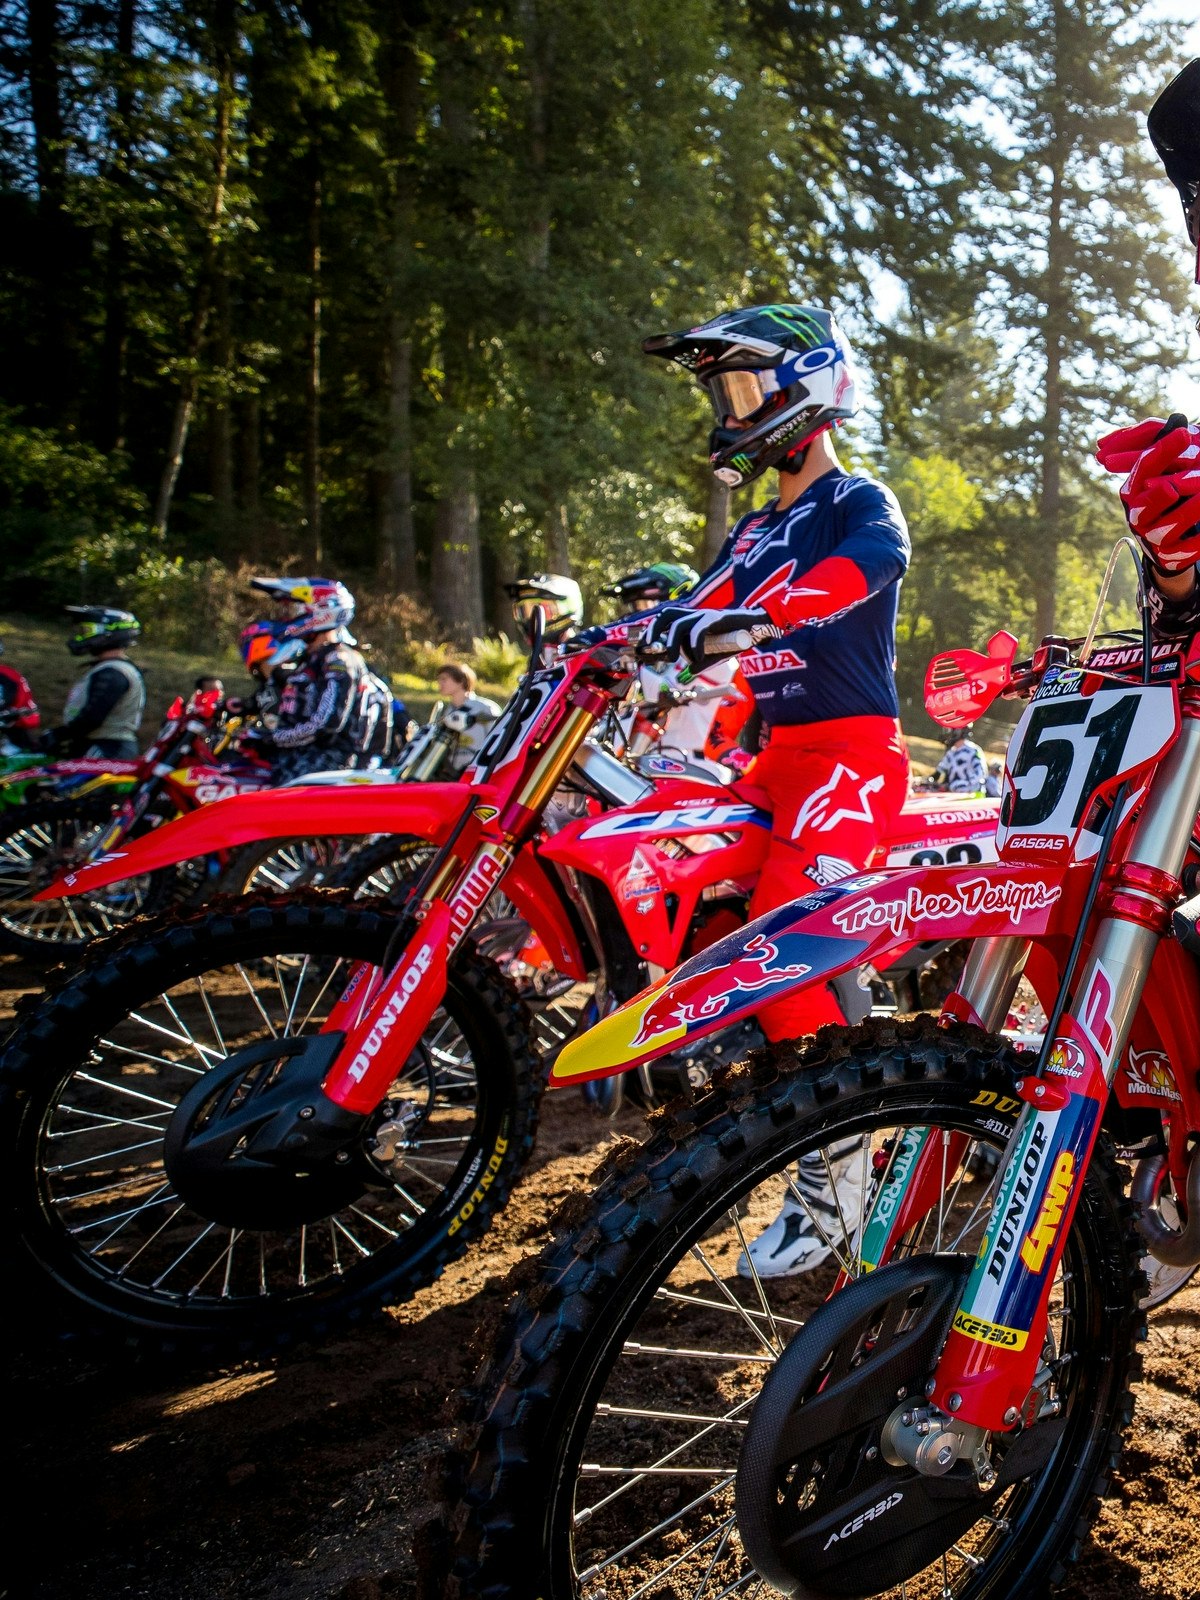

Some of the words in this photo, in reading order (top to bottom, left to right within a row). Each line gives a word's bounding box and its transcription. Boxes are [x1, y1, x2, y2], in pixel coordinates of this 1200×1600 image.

[1033, 683, 1062, 701] LUCAS
[1062, 680, 1081, 694] OIL
[1000, 694, 1143, 828] 51
[577, 803, 758, 840] CRF
[923, 808, 1000, 826] HONDA
[1010, 838, 1065, 850] GASGAS
[833, 897, 907, 936] Troy
[907, 887, 961, 922] Lee
[956, 877, 1062, 924] Designs
[347, 943, 432, 1083] DUNLOP
[447, 1135, 509, 1236] DUNLOP
[987, 1121, 1048, 1286] DUNLOP
[1019, 1150, 1076, 1275] 4WP
[954, 1314, 1018, 1347] ACERBIS
[823, 1492, 904, 1551] ACERBIS
